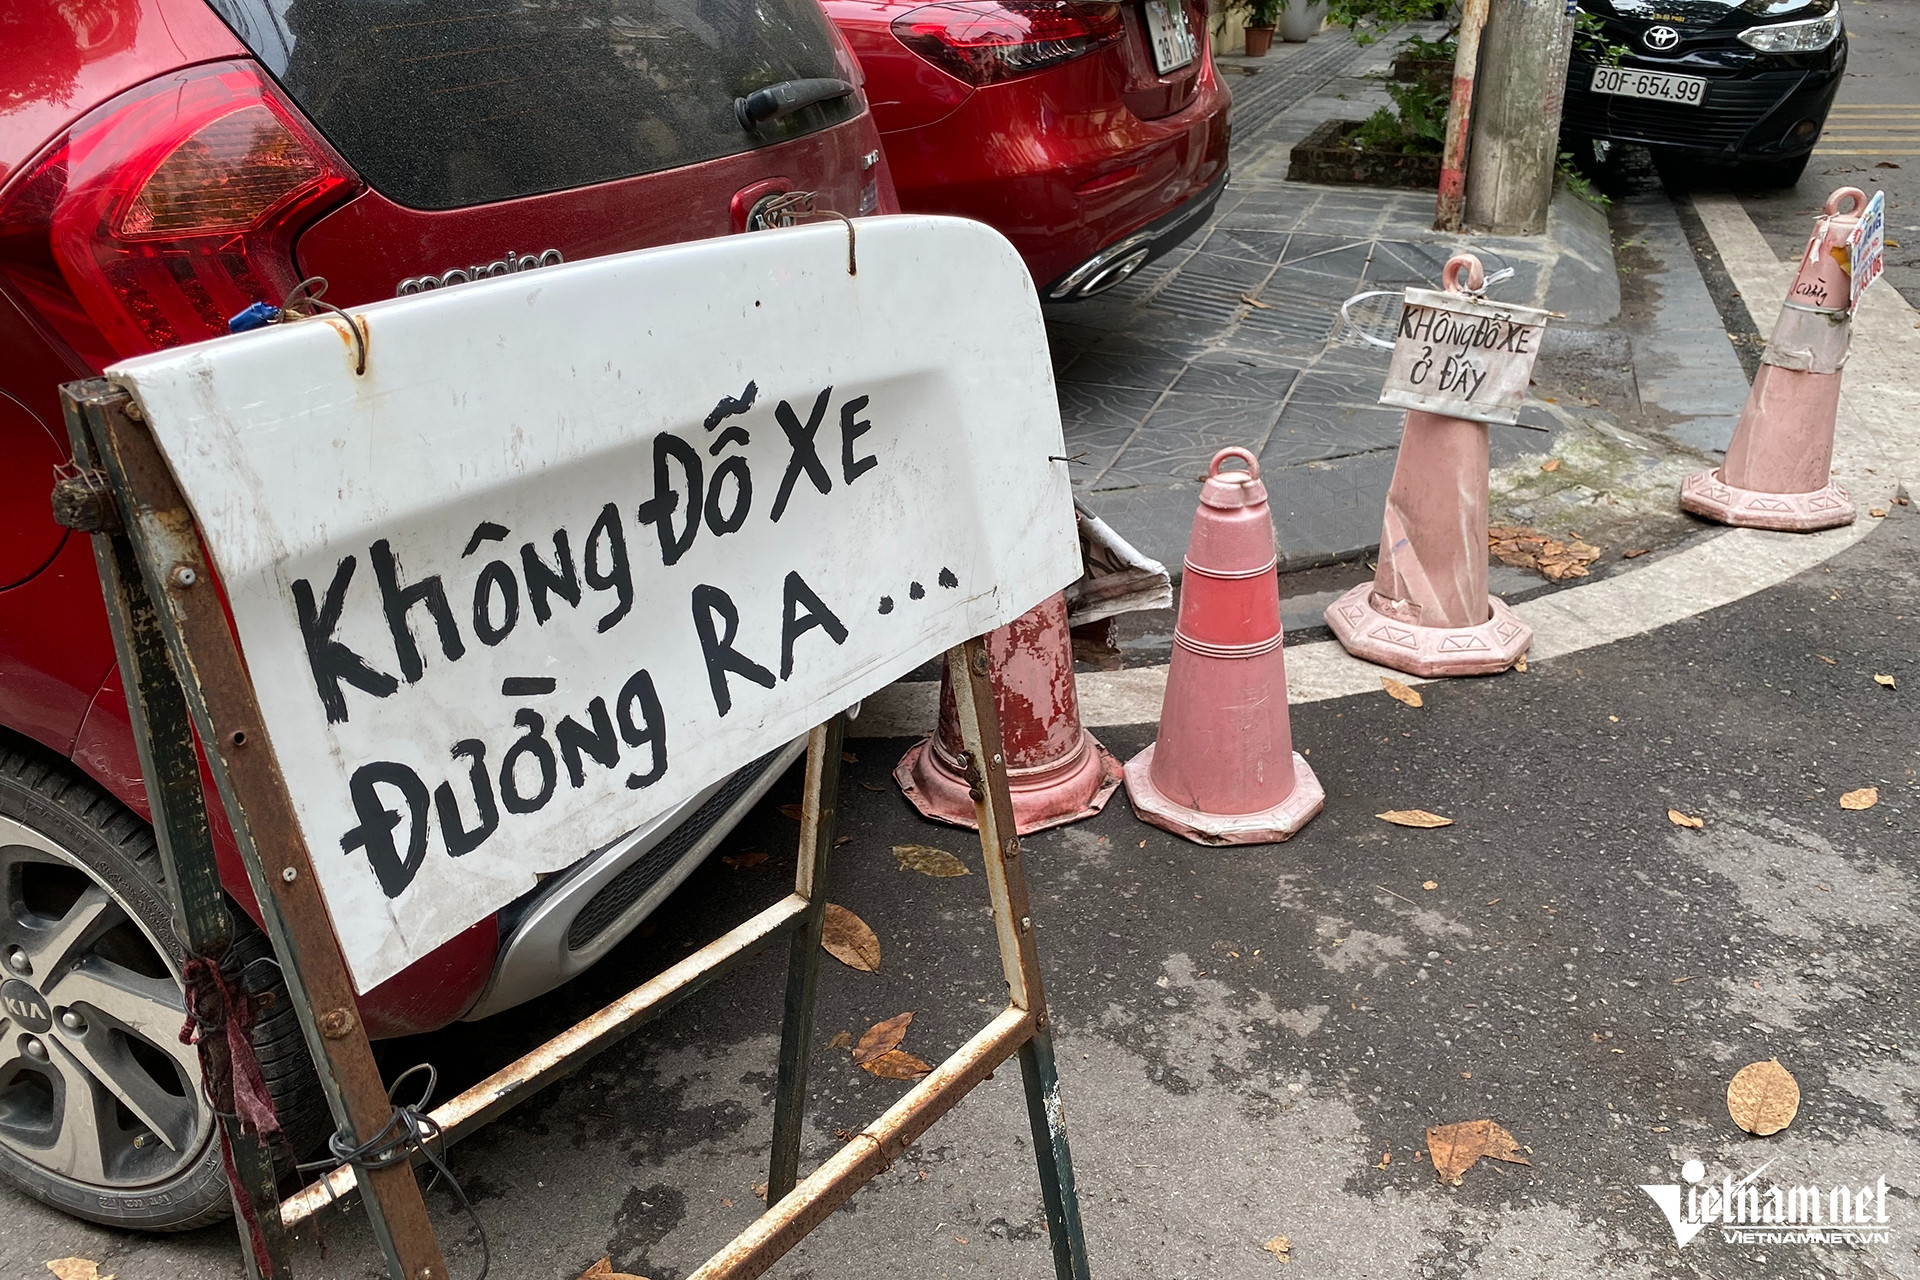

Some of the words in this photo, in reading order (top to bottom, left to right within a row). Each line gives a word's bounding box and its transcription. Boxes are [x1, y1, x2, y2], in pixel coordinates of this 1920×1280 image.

[1594, 70, 1701, 102] 30F-654.99
[1496, 321, 1531, 354] XE
[1410, 345, 1433, 385] Ở
[1438, 356, 1487, 401] ĐÂY
[769, 385, 878, 523] XE
[4, 996, 47, 1020] KIA
